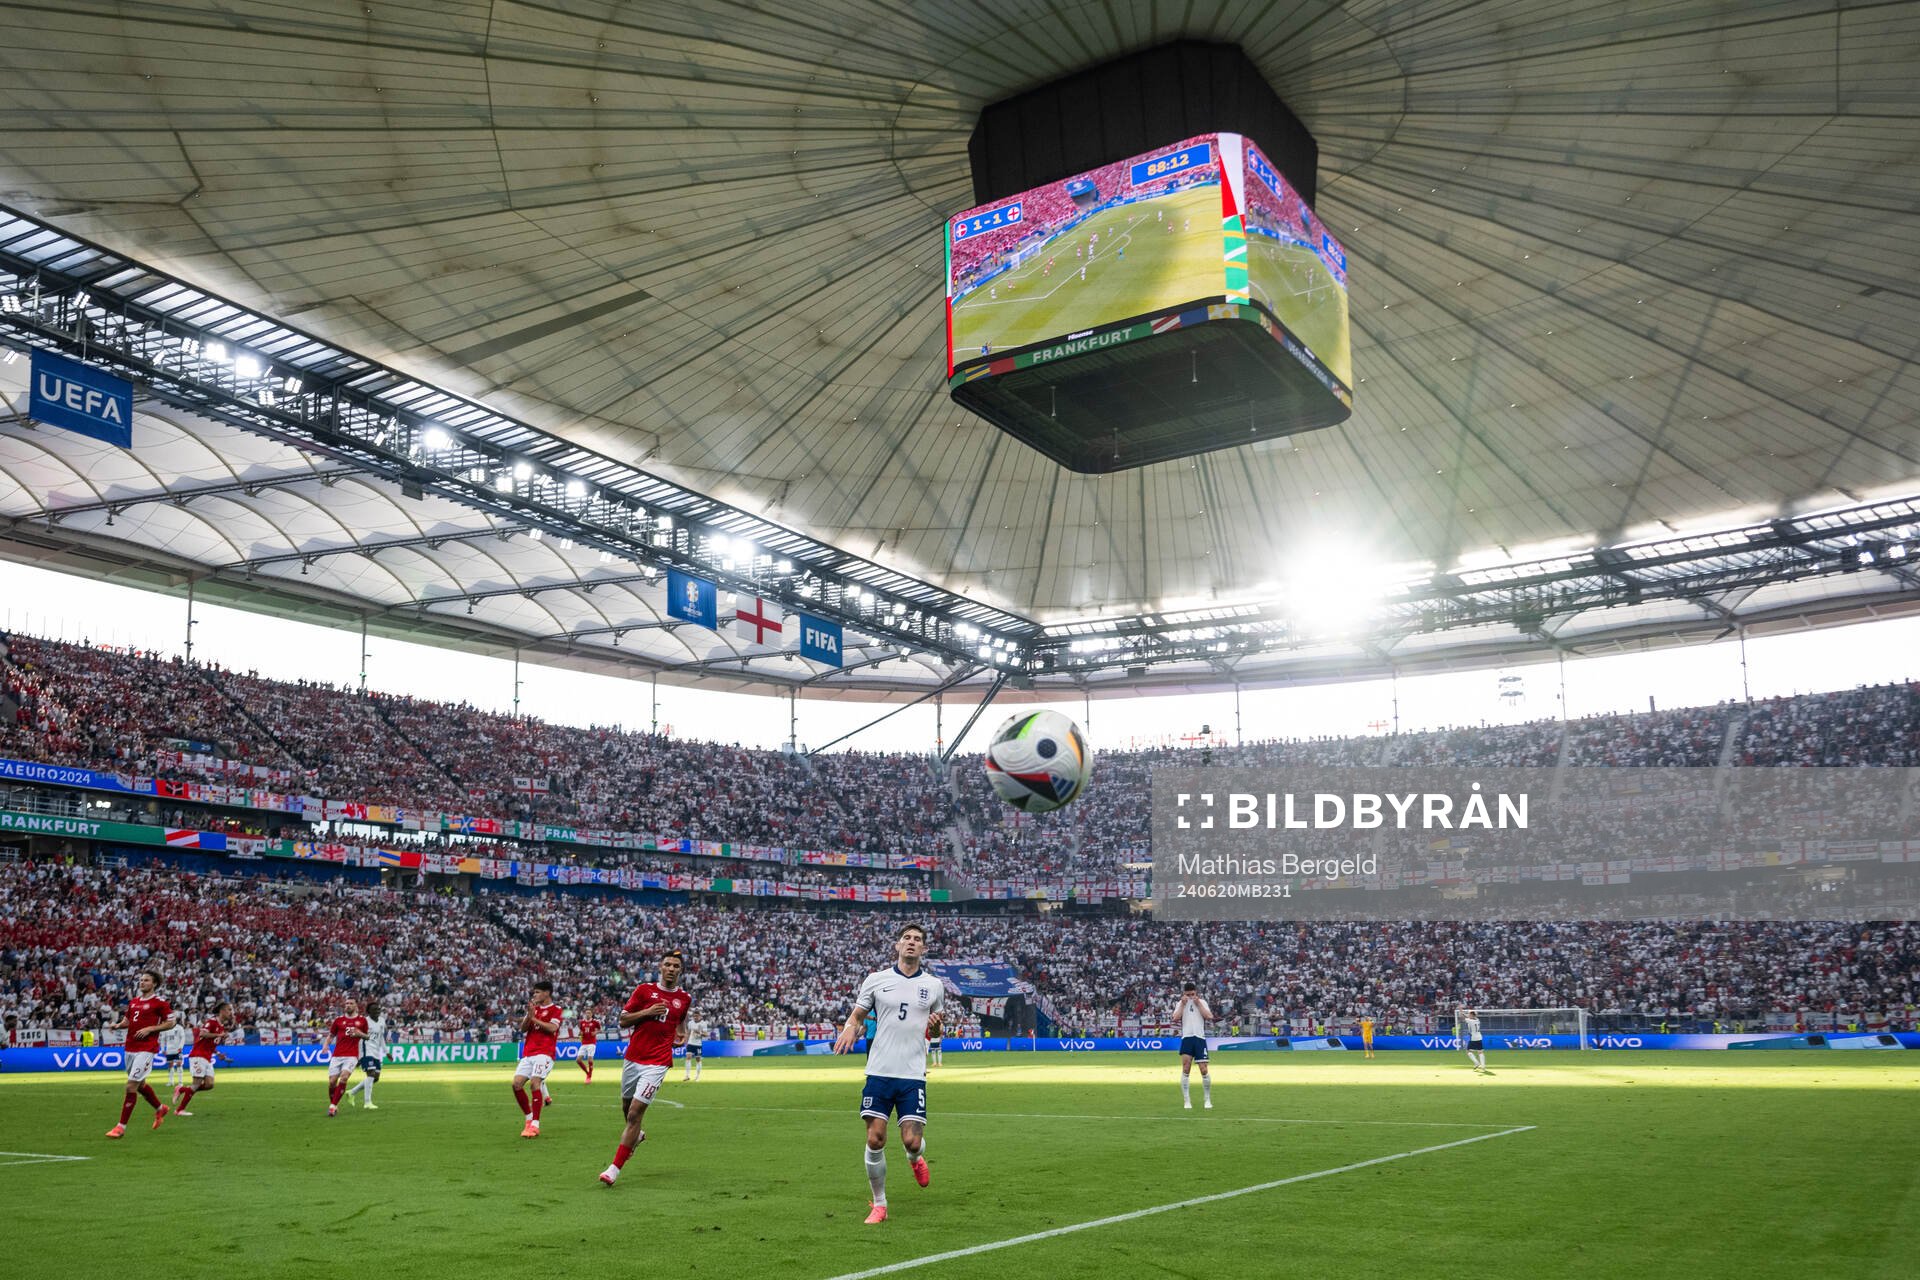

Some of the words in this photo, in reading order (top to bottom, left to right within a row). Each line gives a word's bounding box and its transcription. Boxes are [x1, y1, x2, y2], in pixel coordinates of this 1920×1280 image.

[1147, 153, 1190, 176] 88:12
[1032, 328, 1133, 363] FRANKFURT
[40, 373, 122, 424] UEFA
[806, 628, 838, 653] FIFA
[133, 1010, 140, 1022] 2
[898, 1003, 908, 1021] 5
[962, 1039, 982, 1050] vivo
[1060, 1039, 1095, 1049] vivo
[1125, 1039, 1162, 1049] vivo
[1503, 1036, 1552, 1048] vivo
[1592, 1036, 1642, 1048] vivo
[53, 1049, 122, 1068] vivo
[278, 1047, 332, 1064] vivo
[133, 1068, 140, 1078] 2
[534, 1064, 543, 1075] 15
[641, 1083, 657, 1100] 18
[918, 1088, 926, 1107] 5
